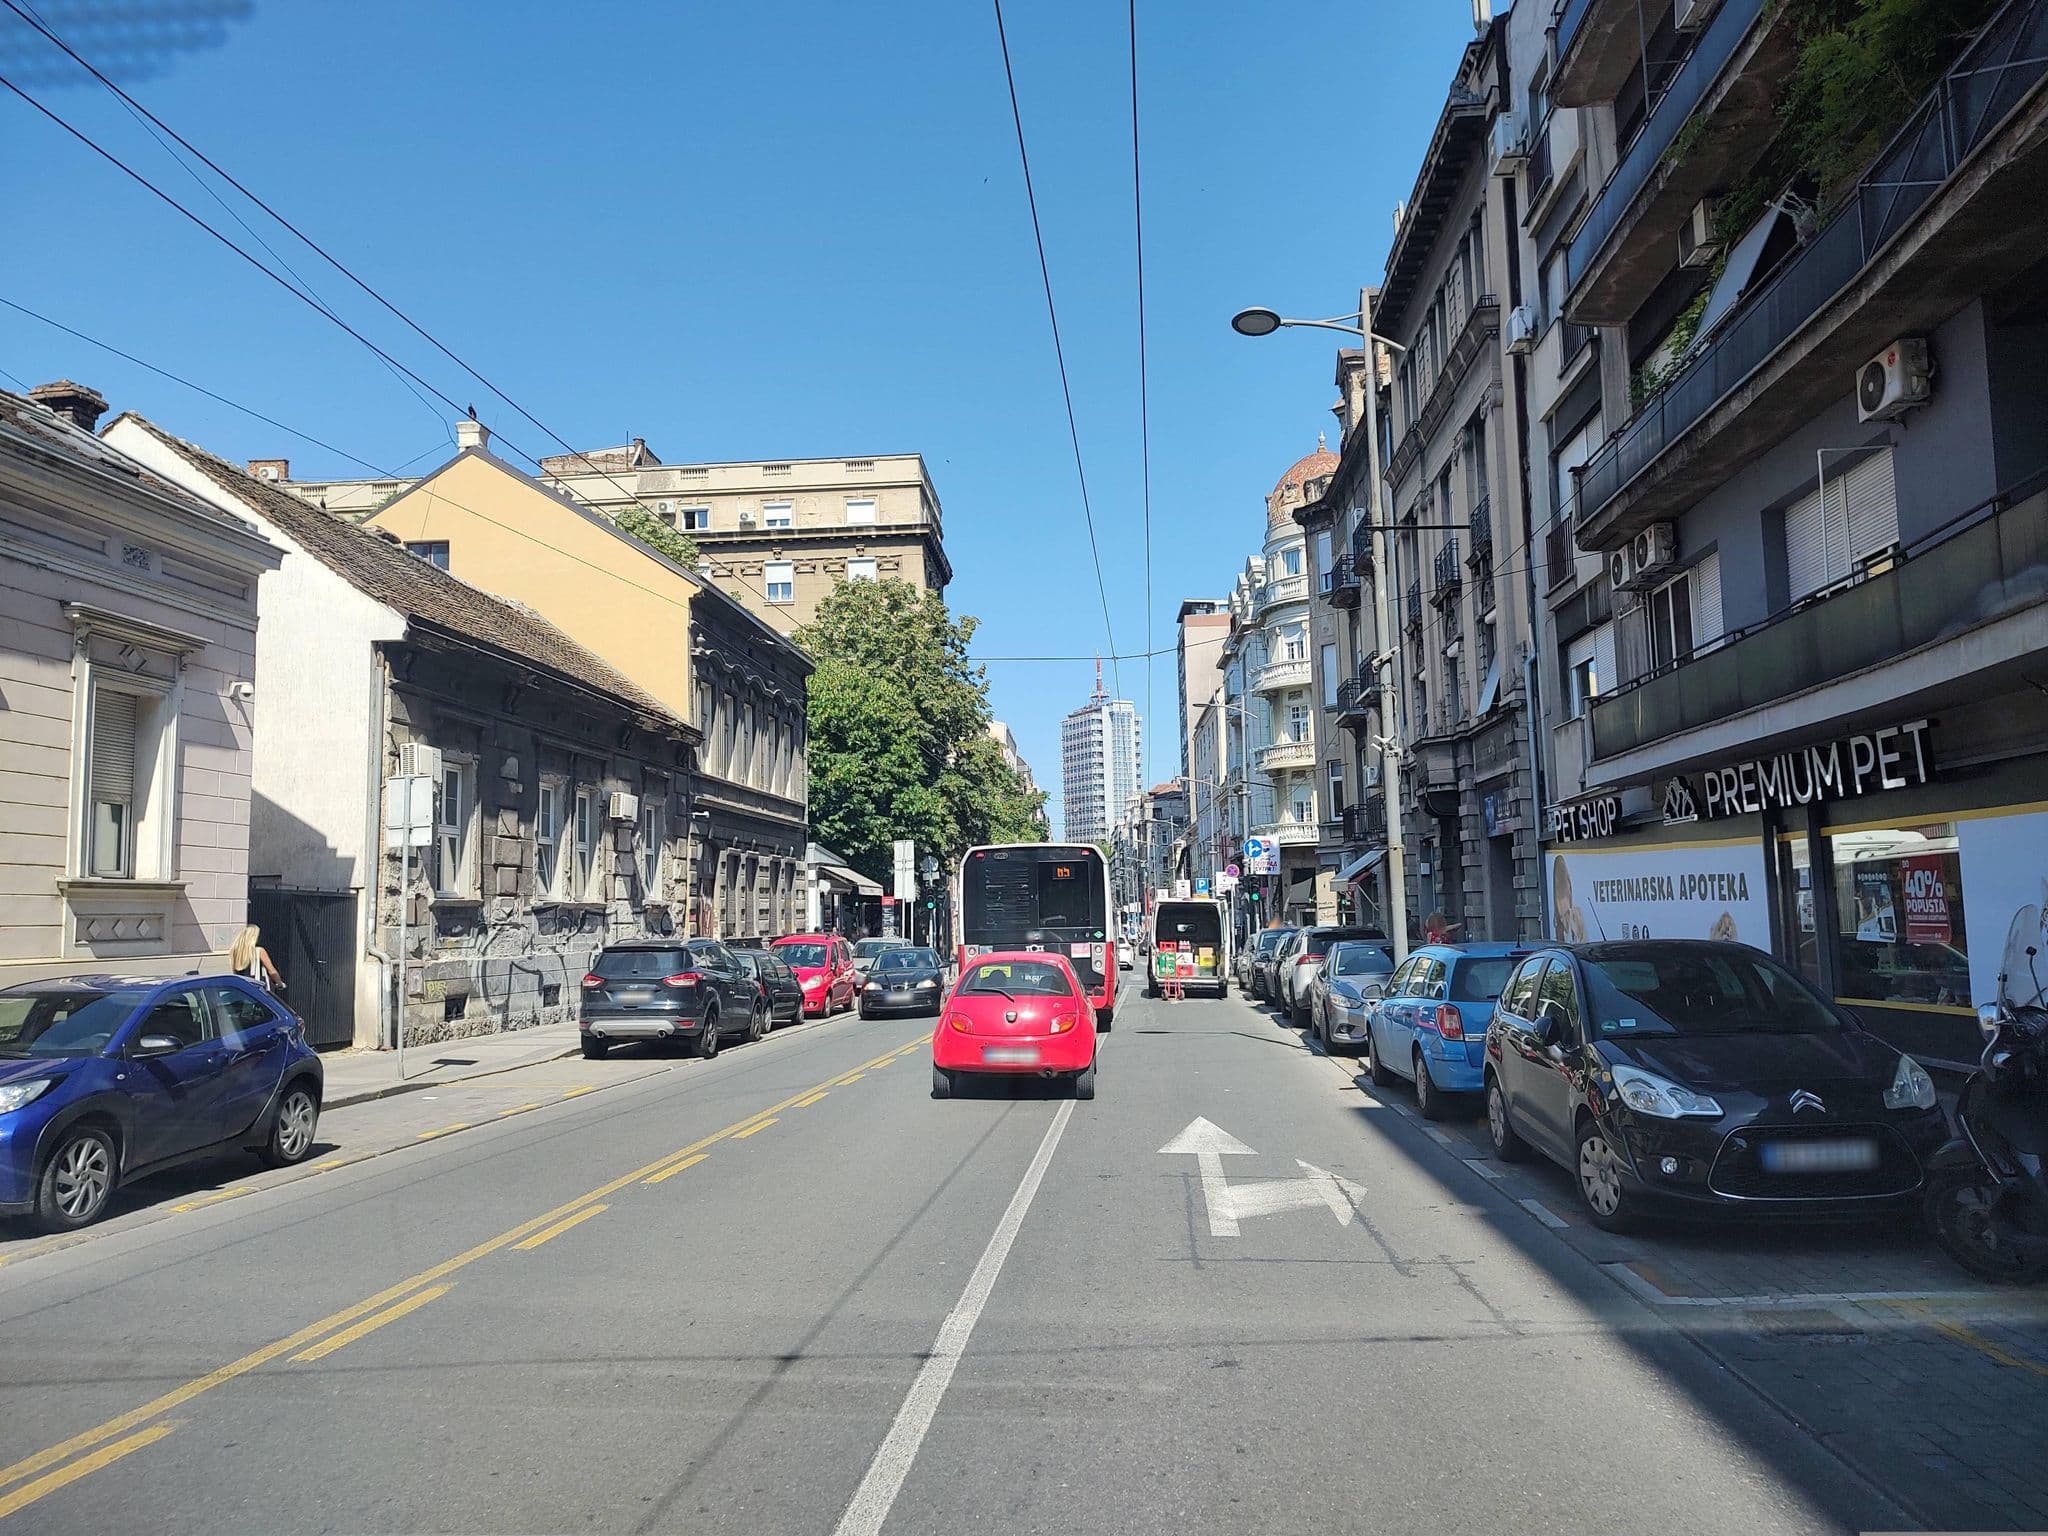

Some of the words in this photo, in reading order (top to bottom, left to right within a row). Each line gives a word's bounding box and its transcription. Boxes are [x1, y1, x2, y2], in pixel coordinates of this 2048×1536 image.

[1704, 741, 1844, 818] PREMIUM
[1850, 719, 1928, 794] PET
[1553, 806, 1576, 844] PET
[1580, 797, 1616, 839] SHOP
[1593, 875, 1675, 902] VETERINARSKA
[1679, 872, 1750, 901] APOTEKA
[1905, 870, 1943, 898] 40%
[1906, 899, 1946, 913] POPUSTA
